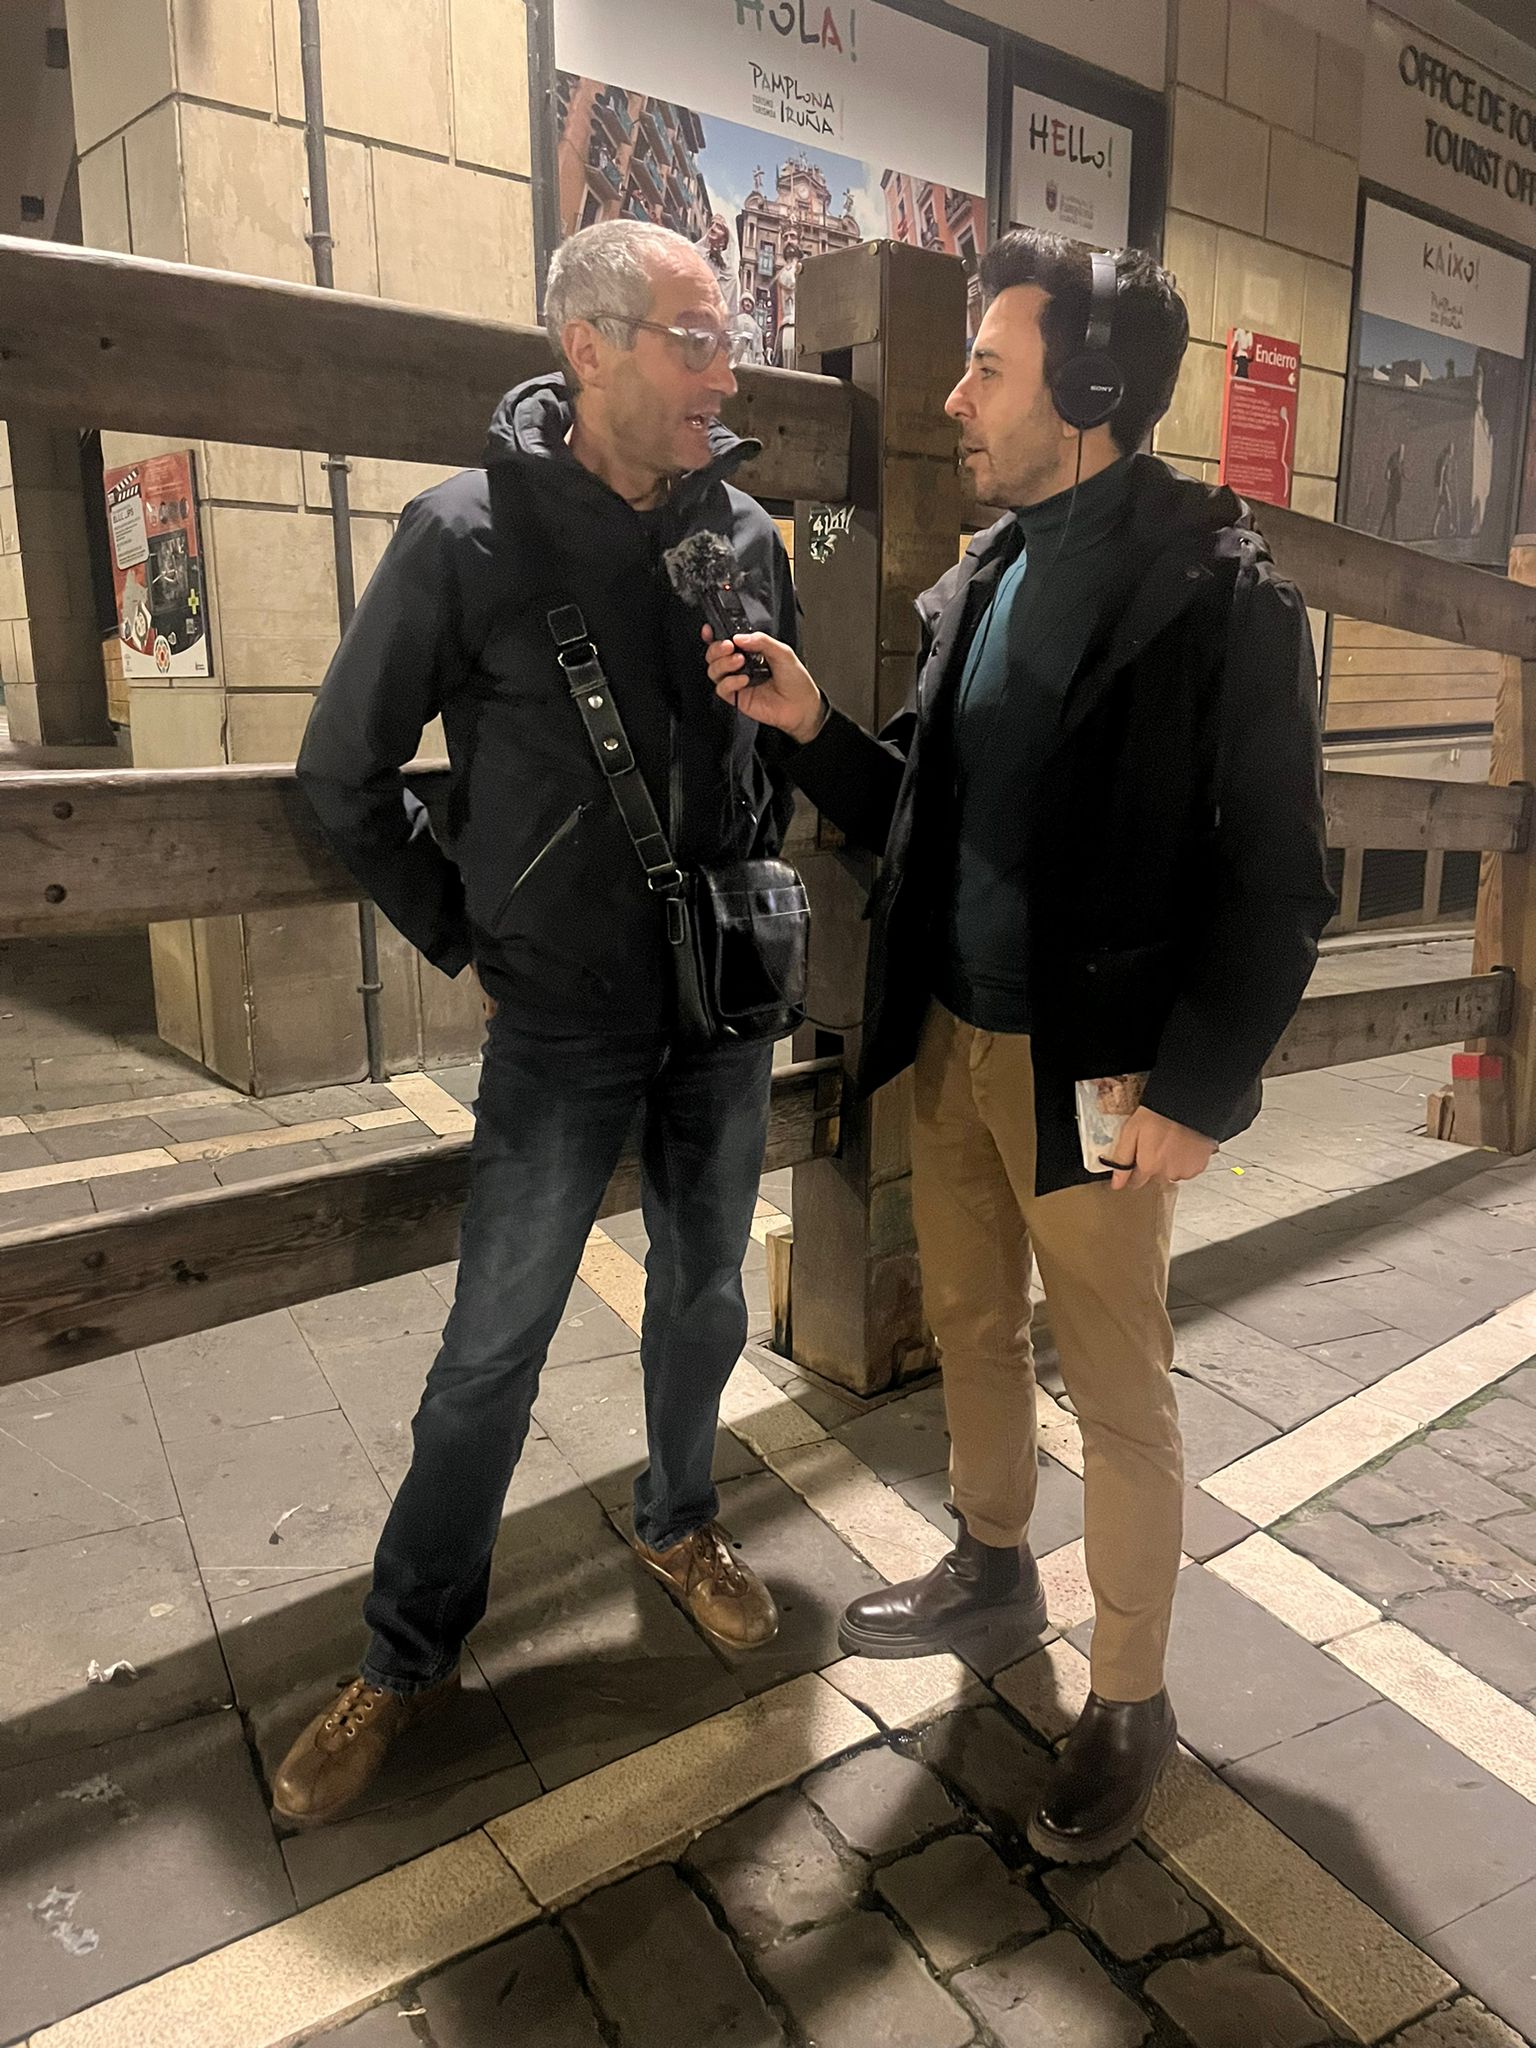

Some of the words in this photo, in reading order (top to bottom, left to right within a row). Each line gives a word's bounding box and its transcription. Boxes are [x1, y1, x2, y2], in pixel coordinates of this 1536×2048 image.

[735, 0, 857, 62] HOLA!
[748, 61, 834, 113] PAMPLONA
[781, 100, 834, 136] IRUÑA
[1399, 45, 1477, 117] OFFICE
[1478, 86, 1507, 134] DE
[1029, 113, 1112, 178] HELLO!
[1425, 118, 1502, 189] TOURIST
[1255, 344, 1297, 370] Encierro
